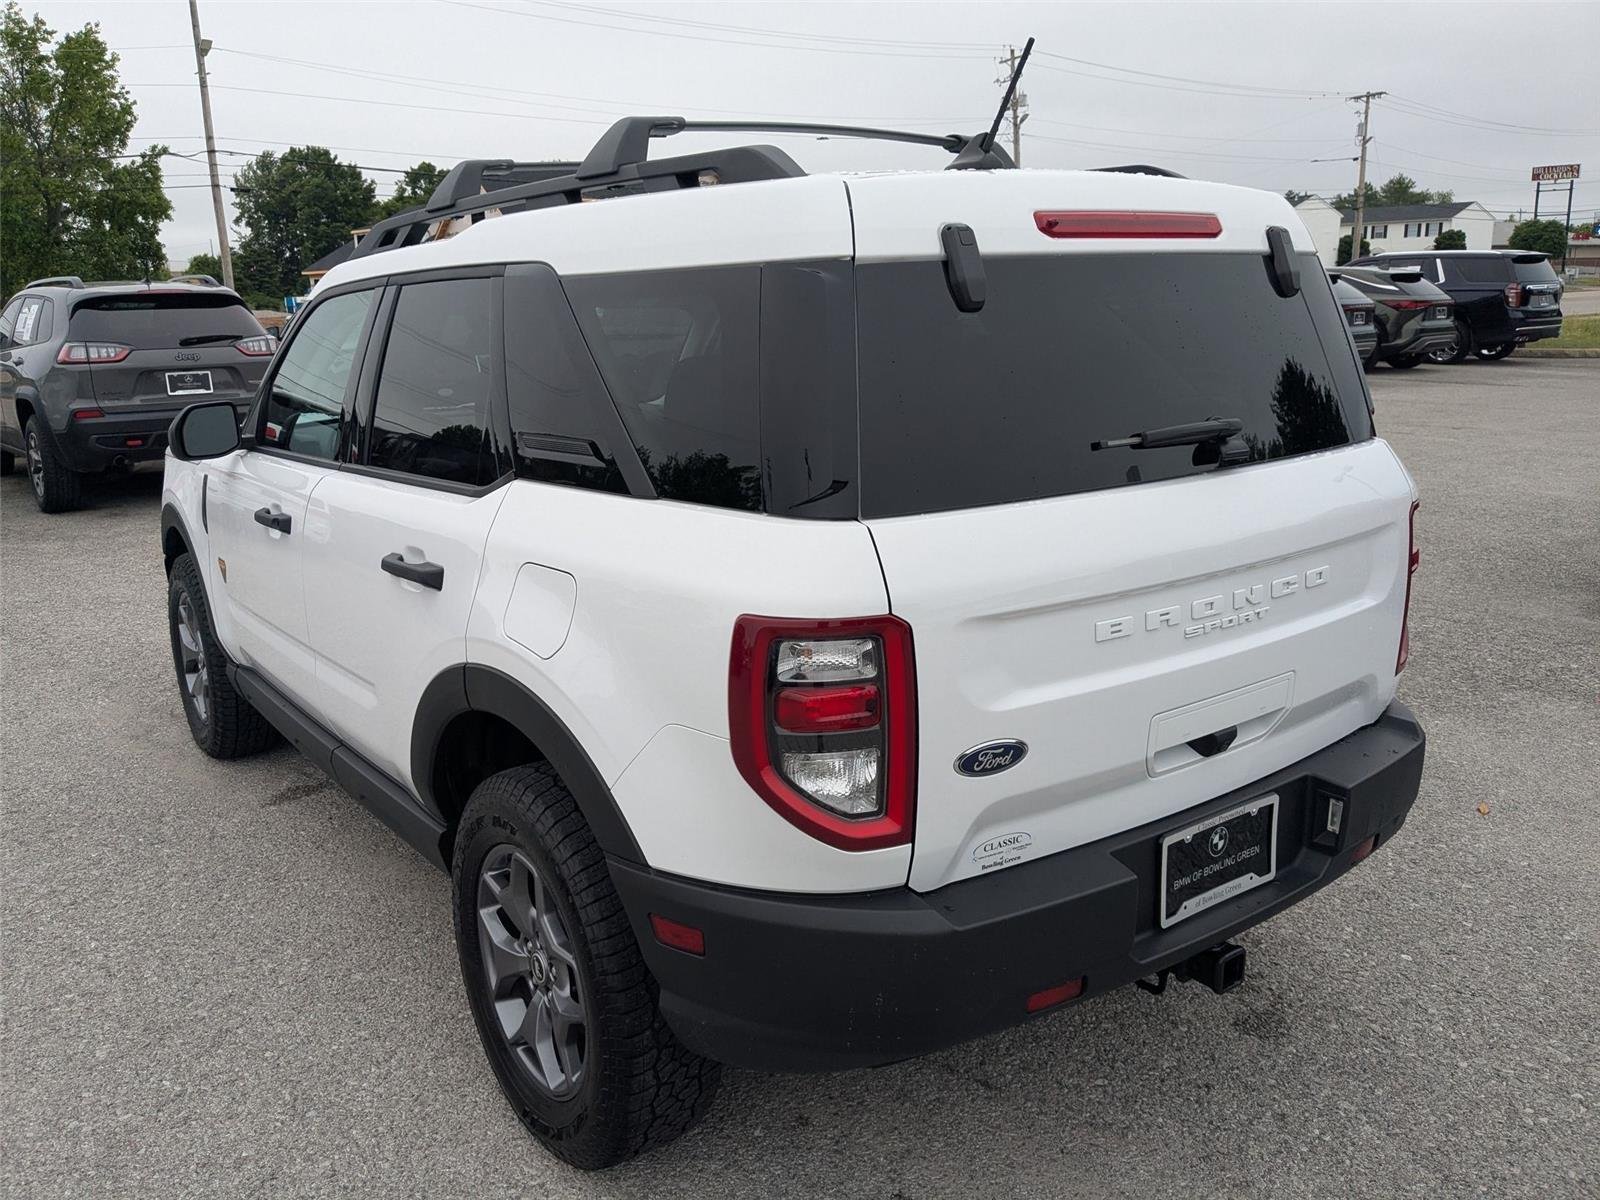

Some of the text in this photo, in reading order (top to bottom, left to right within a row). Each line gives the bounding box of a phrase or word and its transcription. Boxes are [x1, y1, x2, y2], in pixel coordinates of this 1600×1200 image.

[1539, 171, 1578, 180] COCKTAILS
[175, 351, 201, 361] Jeep
[1095, 565, 1329, 642] BRONCO
[1184, 607, 1269, 639] SPORT
[974, 747, 1014, 772] Ford
[983, 835, 1023, 853] CLASSIC
[981, 860, 1004, 870] Bowling
[1004, 855, 1021, 864] Green
[1173, 845, 1260, 890] BMW OF BOWLING GREEN
[1202, 890, 1225, 905] Bowling
[1225, 883, 1242, 896] Green
